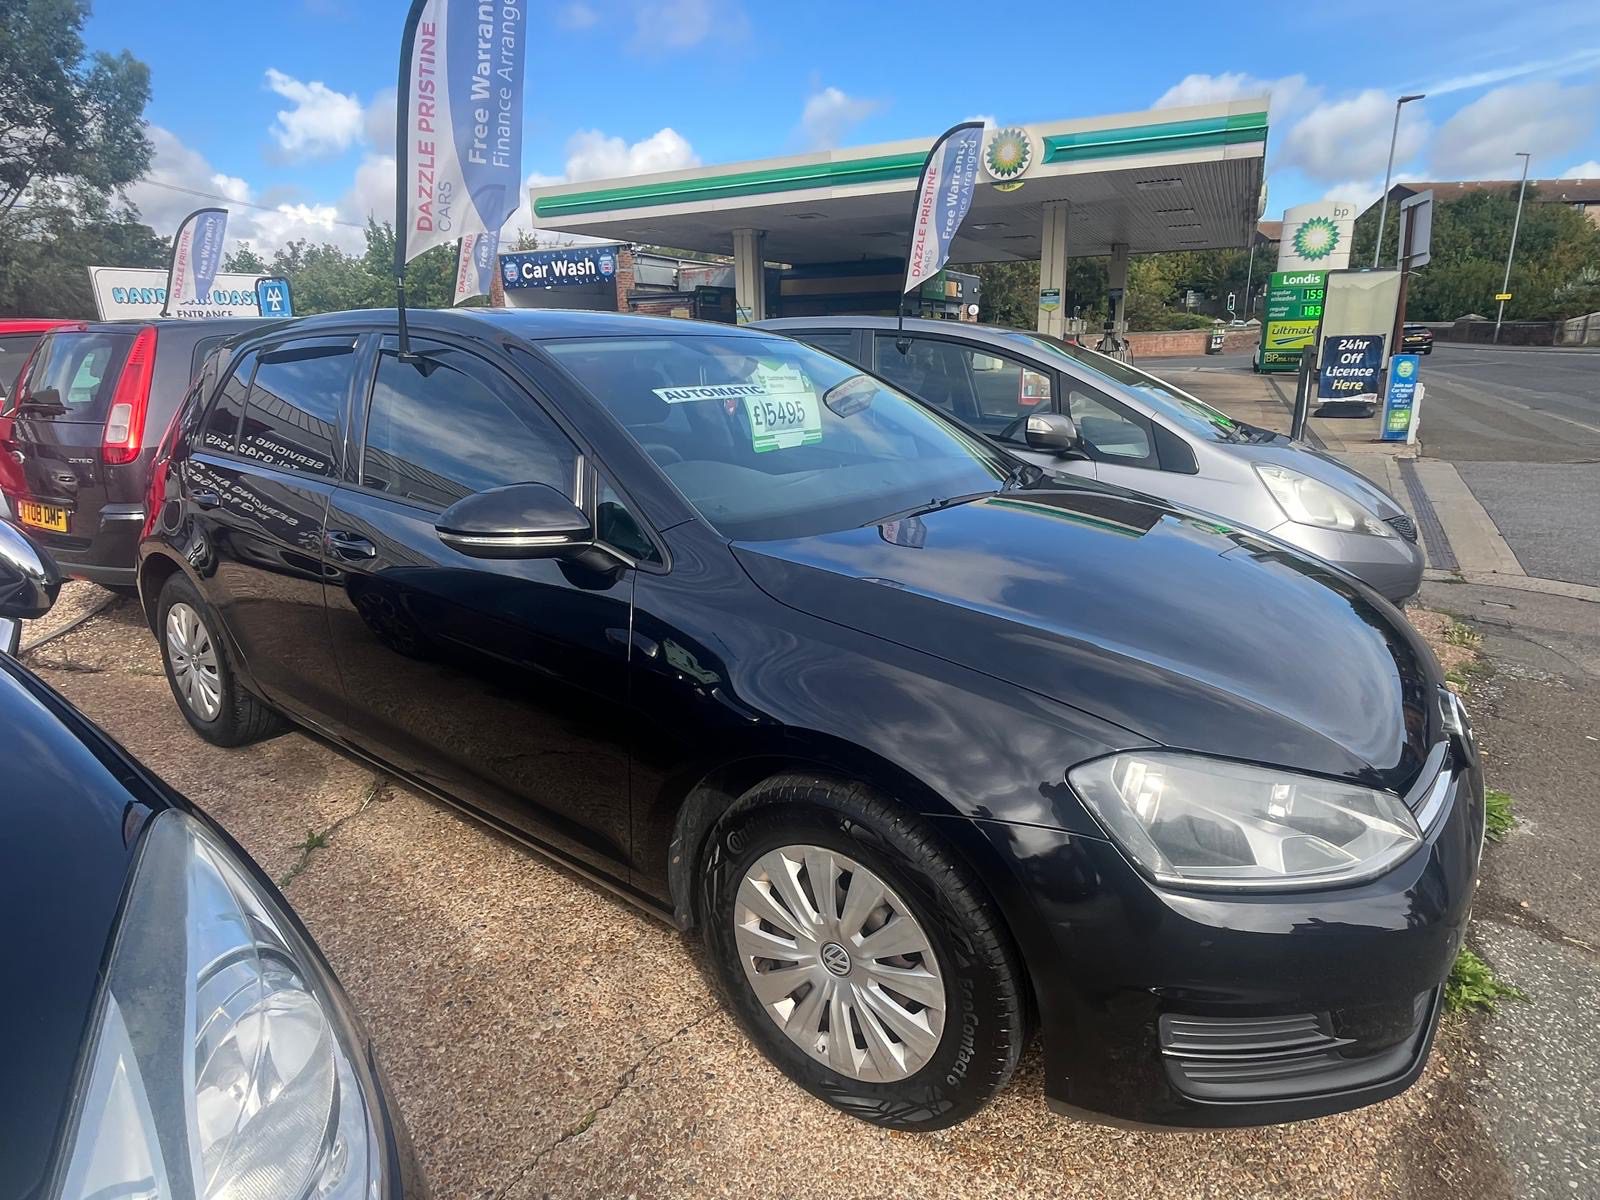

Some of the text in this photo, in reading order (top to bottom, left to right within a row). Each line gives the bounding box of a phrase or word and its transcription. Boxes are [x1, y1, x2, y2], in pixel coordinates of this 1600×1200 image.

[468, 0, 495, 164] Free Warran
[416, 22, 436, 231] DAZZLE PRISTINE
[493, 86, 513, 168] Finance
[961, 140, 977, 195] Arranged
[943, 140, 968, 240] Free Warranty
[438, 181, 452, 232] CARS
[1333, 207, 1349, 218] bp
[912, 167, 937, 277] DAZZLE PRISTINE
[201, 216, 218, 260] Warranty
[479, 245, 489, 269] Free
[522, 257, 596, 279] Car Wash
[198, 260, 207, 279] Free
[458, 257, 469, 293] DAZZLE
[1283, 274, 1321, 285] Londis
[174, 268, 184, 299] DAZZLE
[112, 286, 166, 305] HAND
[1306, 290, 1324, 300] 159
[176, 310, 233, 318] ENTRANCE
[1304, 306, 1322, 316] 183
[1338, 339, 1370, 350] 24hr
[1340, 353, 1364, 364] Off
[1326, 366, 1374, 377] Licence
[663, 385, 766, 400] AUTOMATIC
[1332, 380, 1364, 390] Here
[946, 977, 980, 1088] EcoContact 6
